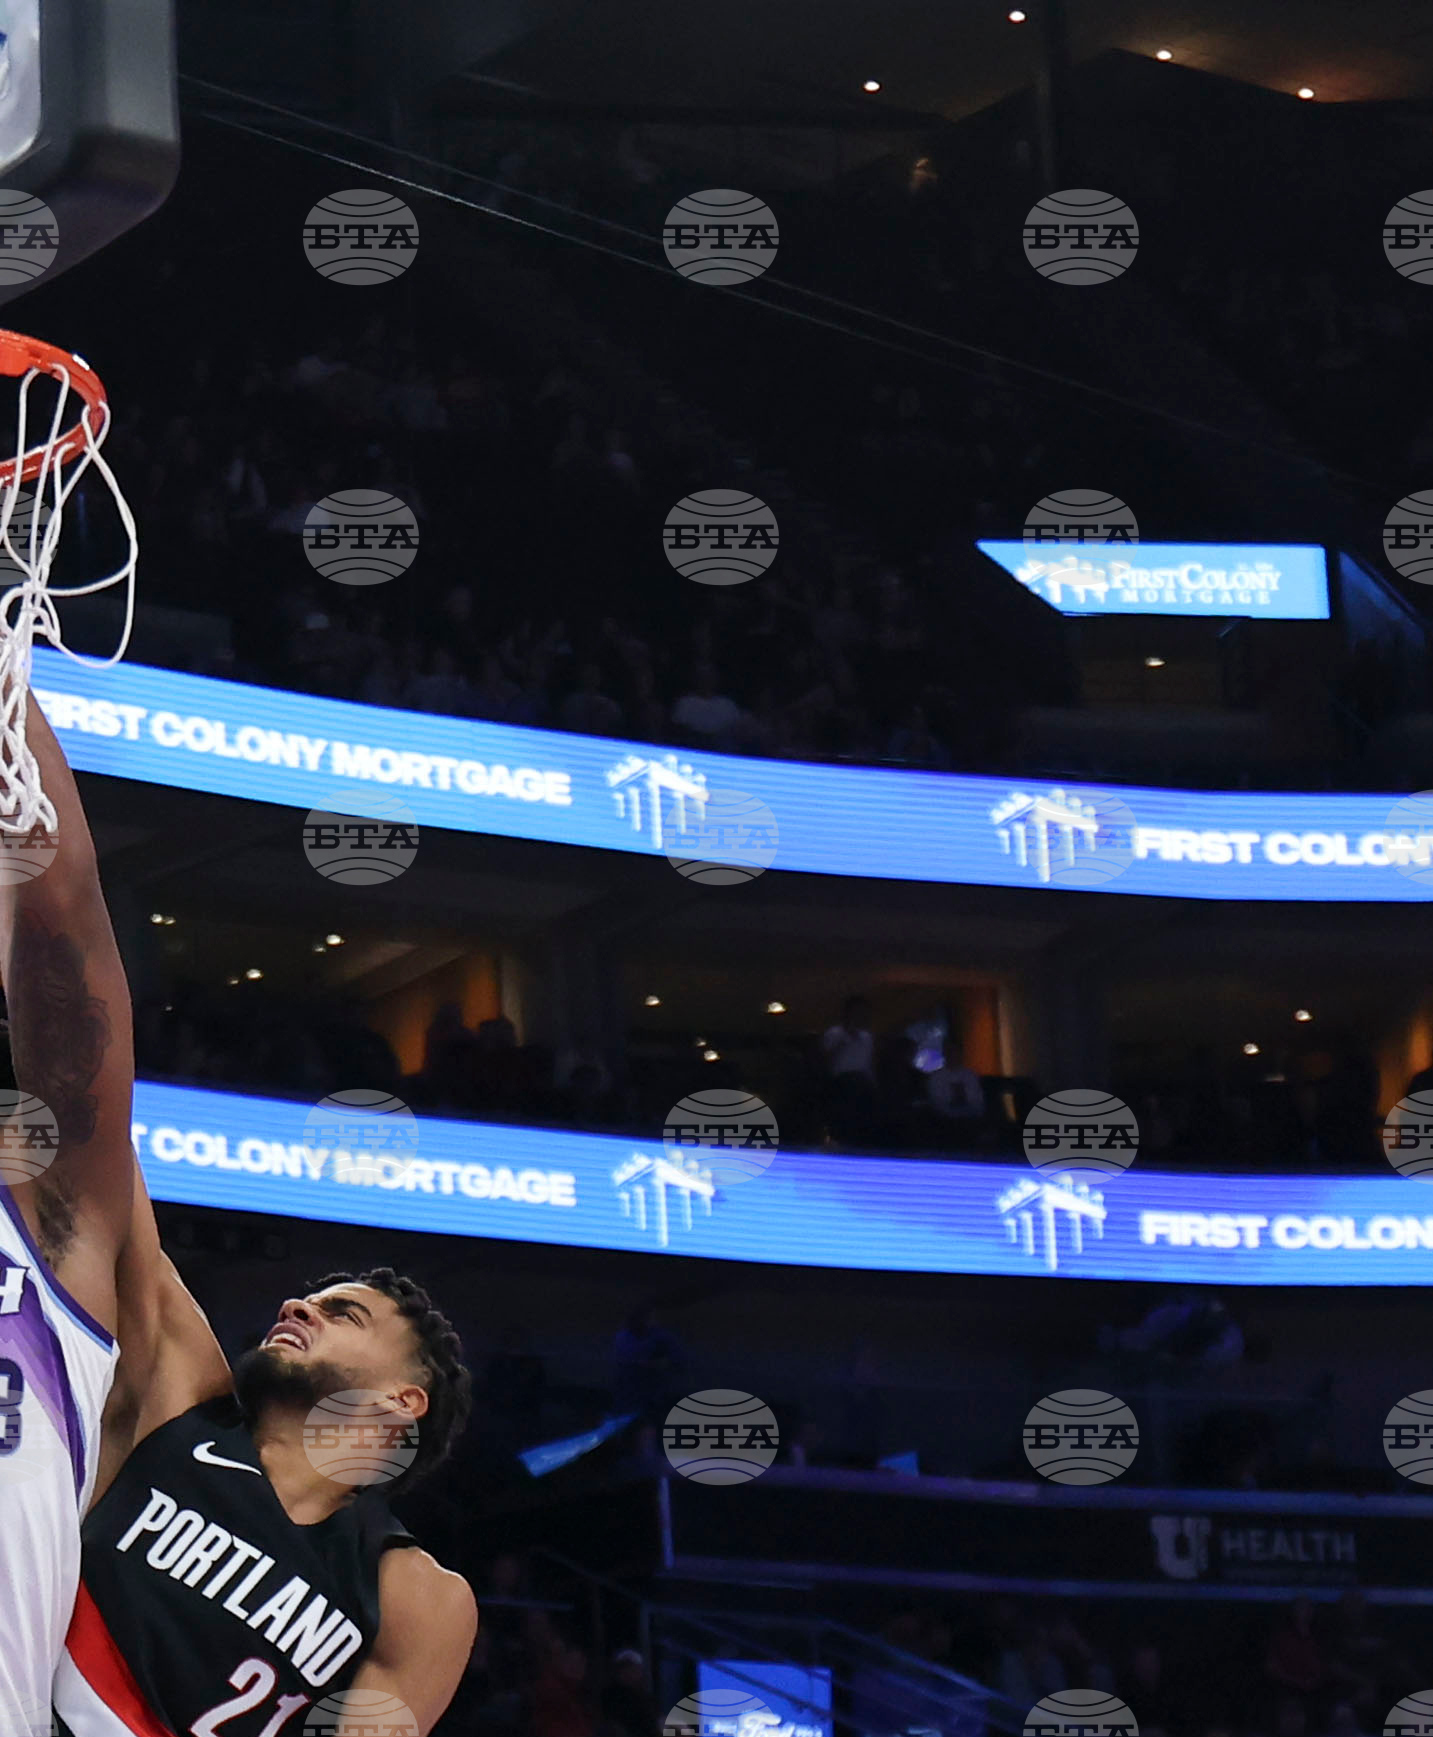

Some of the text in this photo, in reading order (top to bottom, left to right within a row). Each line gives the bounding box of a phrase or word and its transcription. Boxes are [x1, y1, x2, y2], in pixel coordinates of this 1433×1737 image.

[150, 711, 329, 772] COLONY
[331, 740, 573, 806] MORTGAGE
[1133, 826, 1261, 864] FIRST
[151, 1127, 320, 1181] COLONY
[334, 1151, 576, 1207] MORTGAGE
[1140, 1210, 1267, 1249] FIRST
[1221, 1530, 1356, 1562] HEALTH
[116, 1487, 363, 1687] PORTLAND
